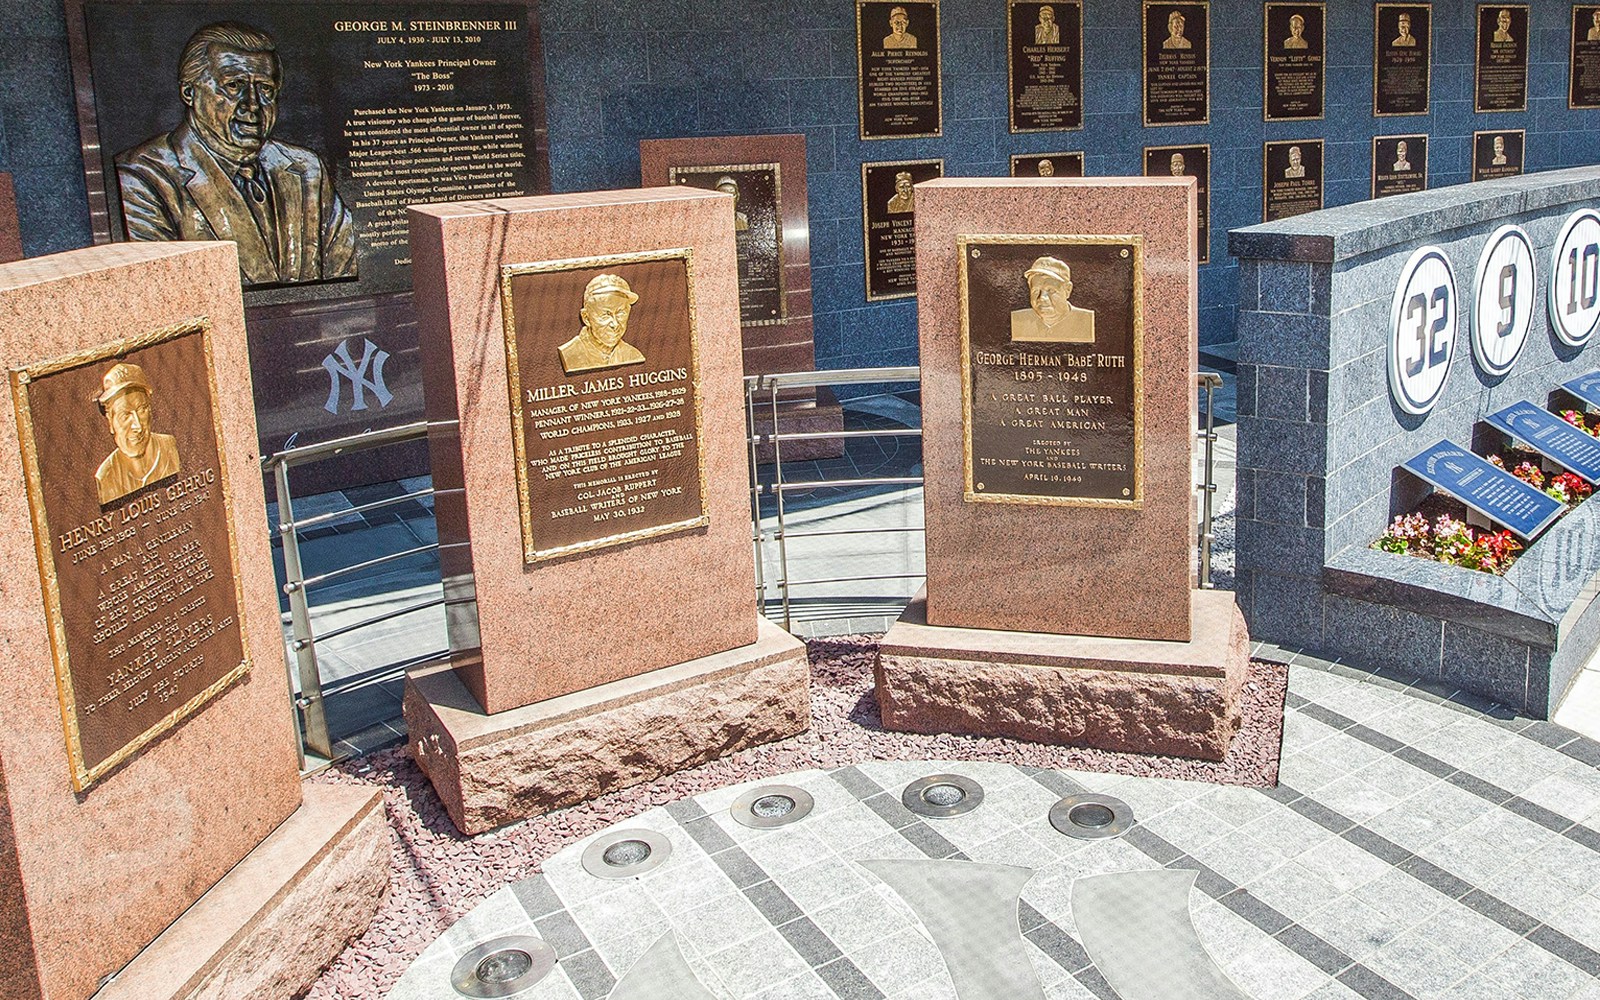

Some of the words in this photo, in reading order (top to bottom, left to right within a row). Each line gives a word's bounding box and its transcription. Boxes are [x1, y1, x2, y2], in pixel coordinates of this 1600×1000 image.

[334, 20, 388, 32] GEORGE
[391, 21, 406, 31] M.
[410, 20, 502, 31] STEINBRENNER
[504, 20, 517, 30] III
[377, 36, 396, 44] JULY
[398, 36, 406, 44] 4,
[408, 36, 424, 44] 1930
[432, 36, 450, 44] JULY
[453, 36, 464, 44] 13,
[364, 60, 382, 68] New
[384, 60, 402, 68] York
[438, 59, 470, 68] Principal
[411, 72, 430, 80] "The
[432, 72, 454, 80] Boss"
[354, 108, 386, 116] Purchased
[892, 219, 912, 227] VINCENT
[1566, 243, 1600, 315] 10
[1496, 264, 1518, 338] 9
[1406, 284, 1449, 378] 32
[976, 352, 1015, 366] GEORGE
[1020, 353, 1061, 366] HERMAN
[1098, 354, 1125, 368] RUTH
[1014, 371, 1043, 381] 1895
[1058, 372, 1087, 382] 1948
[527, 384, 579, 402] MILLER
[581, 377, 624, 394] JAMES
[629, 368, 687, 387] HUGGINS
[531, 406, 568, 417] MANAGER
[569, 404, 579, 412] OF
[581, 400, 599, 410] NEW
[601, 396, 621, 406] YORK
[990, 393, 997, 401] A
[1003, 394, 1035, 402] GREAT
[1043, 394, 1068, 403] BALL
[1074, 396, 1114, 404] PLAYER
[1027, 408, 1060, 416] GREAT
[1067, 409, 1089, 417] MAN
[535, 416, 571, 428] PENNANT
[1012, 420, 1044, 428] GREAT
[1051, 421, 1106, 430] AMERICAN
[540, 428, 569, 439] WORLD
[564, 444, 590, 454] TRIBUTE
[608, 436, 638, 446] SPLENDID
[640, 429, 676, 440] CHARACTER
[571, 450, 601, 460] PRICELESS
[604, 441, 652, 454] CONTRIBUTION
[665, 434, 693, 443] BASEBALL
[1025, 447, 1041, 455] THE
[1044, 448, 1080, 456] YANKEES
[542, 465, 557, 473] AND
[588, 457, 606, 465] FIELD
[608, 451, 637, 461] BROUGHT
[640, 447, 660, 455] GLORY
[545, 471, 561, 480] NEW
[563, 468, 581, 476] YORK
[583, 465, 598, 473] CLUB
[624, 455, 656, 465] AMERICAN
[659, 450, 681, 459] LEAGUE
[1021, 460, 1044, 468] YORK
[1047, 461, 1087, 470] BASEBALL
[1089, 463, 1127, 471] WRITERS
[1064, 475, 1082, 483] 1949
[596, 487, 622, 497] JACOB
[624, 479, 657, 491] RUPPERT
[58, 512, 114, 552] HENRY
[120, 493, 160, 524] LOUIS
[166, 468, 214, 501] GEHRIG
[551, 506, 587, 518] BASEBALL
[590, 498, 625, 510] WRITERS
[628, 495, 638, 503] OF
[641, 491, 658, 501] NEW
[661, 487, 682, 497] YORK
[594, 512, 610, 522] MAY
[628, 506, 645, 515] 1932
[101, 564, 108, 574] A
[145, 521, 192, 550] GENTLEMAN
[98, 588, 106, 600] A
[110, 571, 138, 592] GREAT
[169, 539, 201, 561] PLAYER
[97, 590, 128, 612] WHOSE
[132, 568, 170, 595] AMAZING
[174, 550, 204, 573] RECORD
[107, 648, 158, 687] YANKEE
[165, 614, 213, 650] PLAYERS
